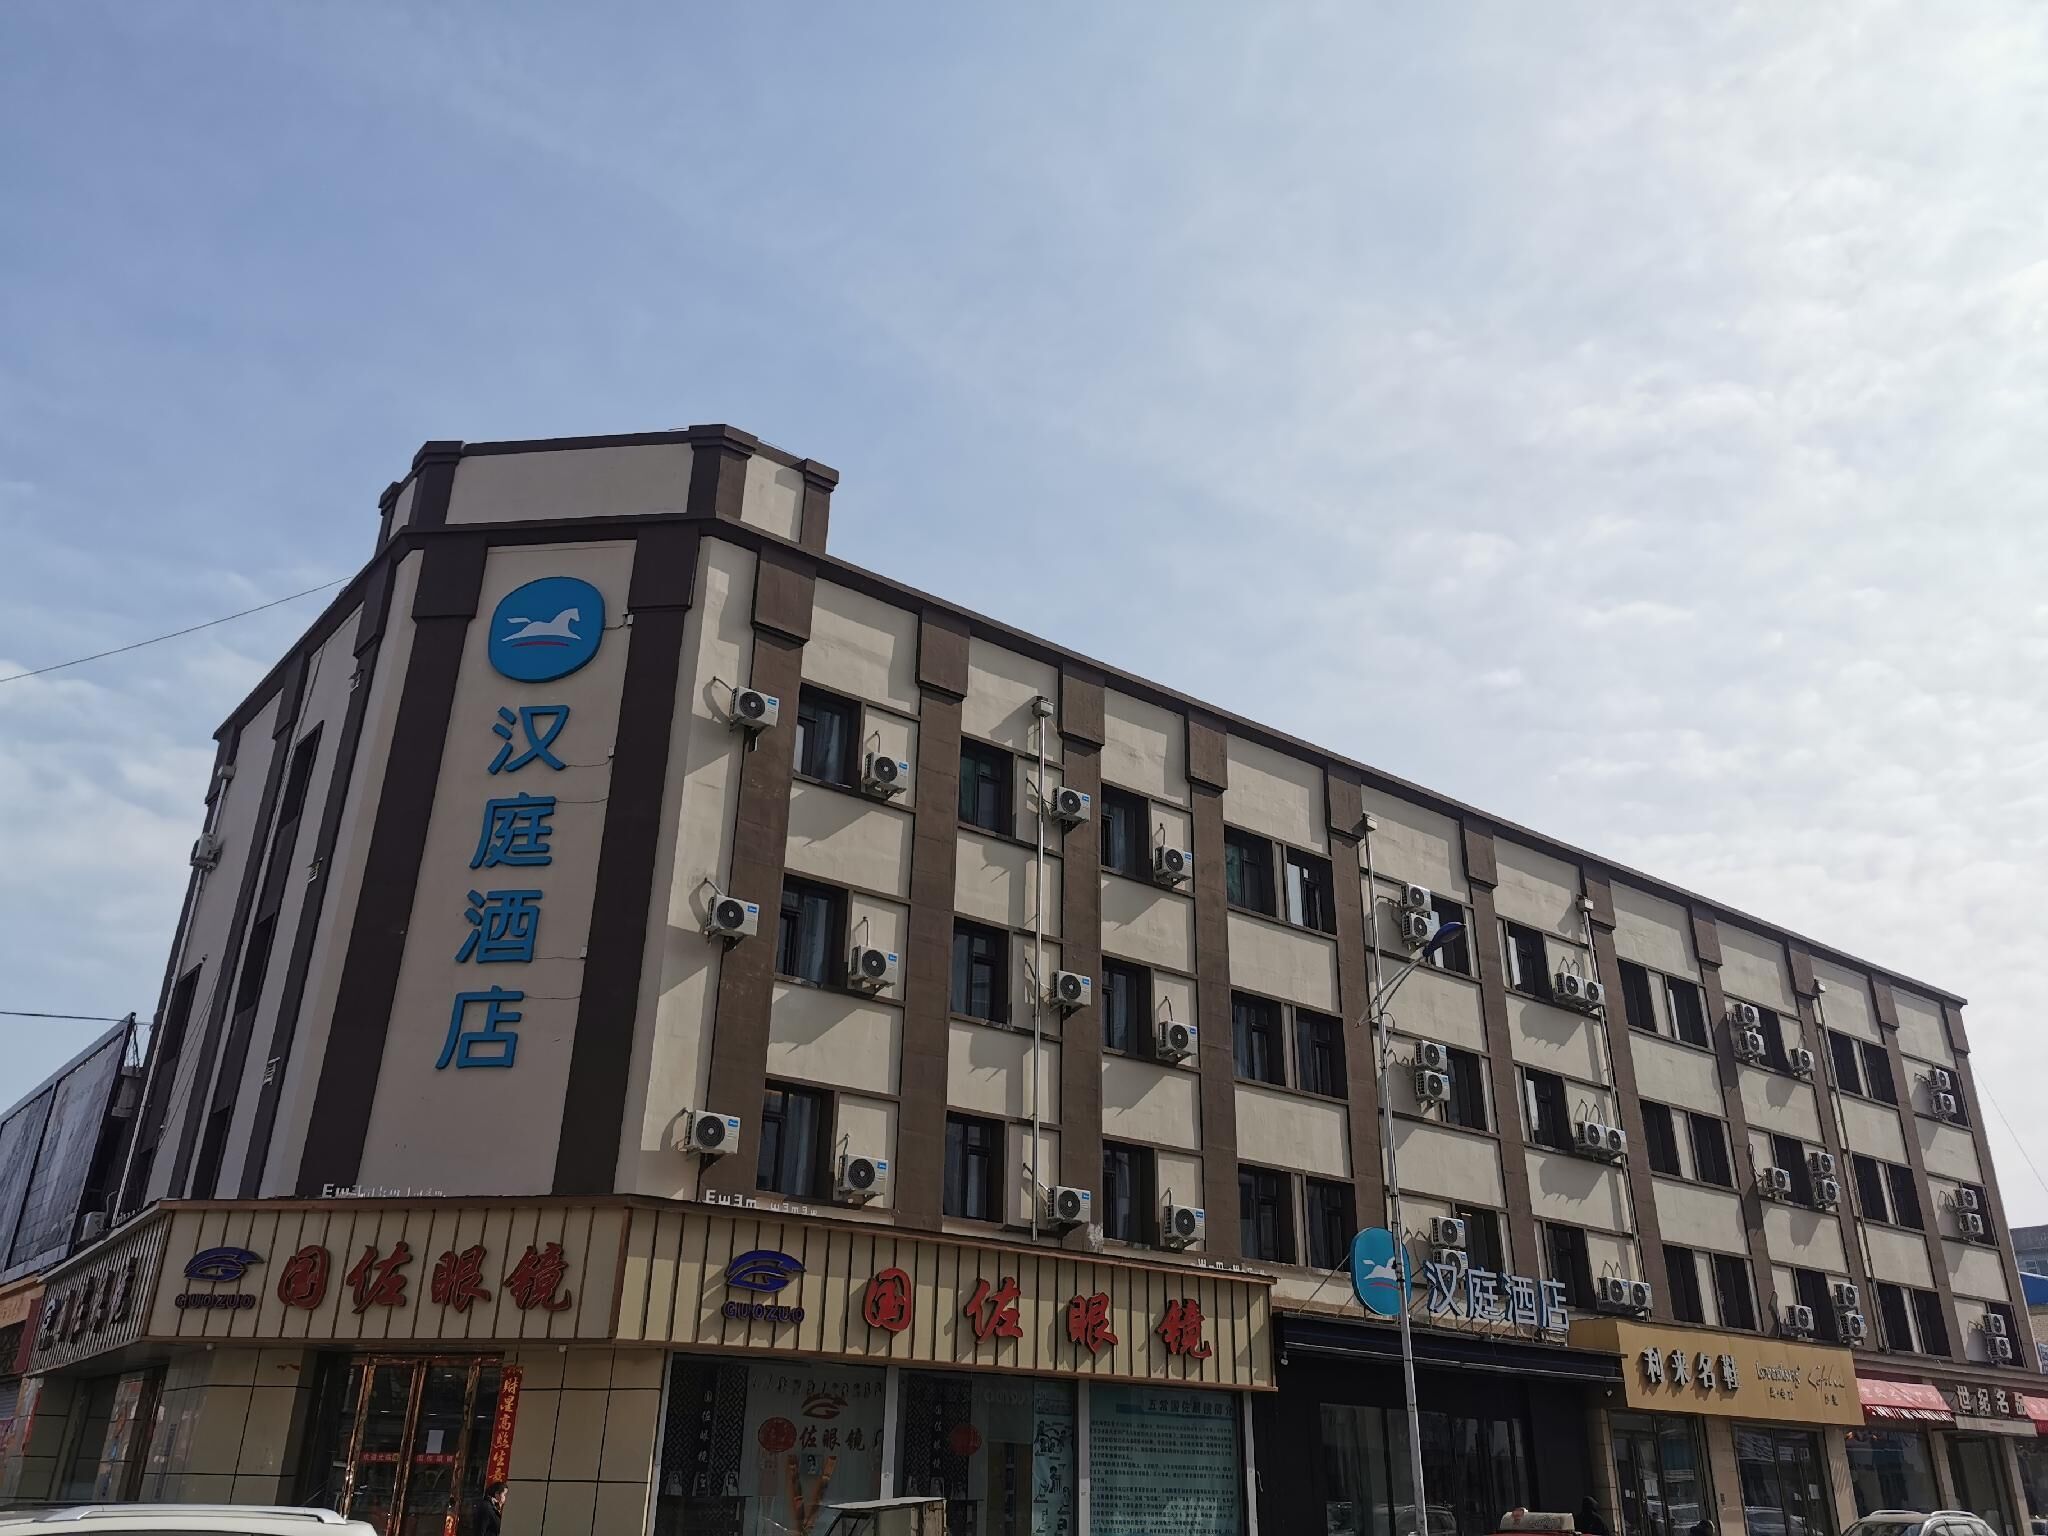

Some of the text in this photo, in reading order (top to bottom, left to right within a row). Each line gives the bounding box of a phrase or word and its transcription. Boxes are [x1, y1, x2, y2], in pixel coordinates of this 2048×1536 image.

[435, 703, 571, 1070] 汉庭酒店
[175, 1293, 256, 1309] GUOZUO
[277, 1241, 573, 1314] 国佐眼镜
[1424, 1260, 1570, 1332] 汉庭酒店
[721, 1301, 805, 1323] GUOZUO
[864, 1267, 1212, 1360] 国佐眼镜
[1642, 1346, 1742, 1390] 利来名鞋
[1956, 1384, 2027, 1416] 世纪名品
